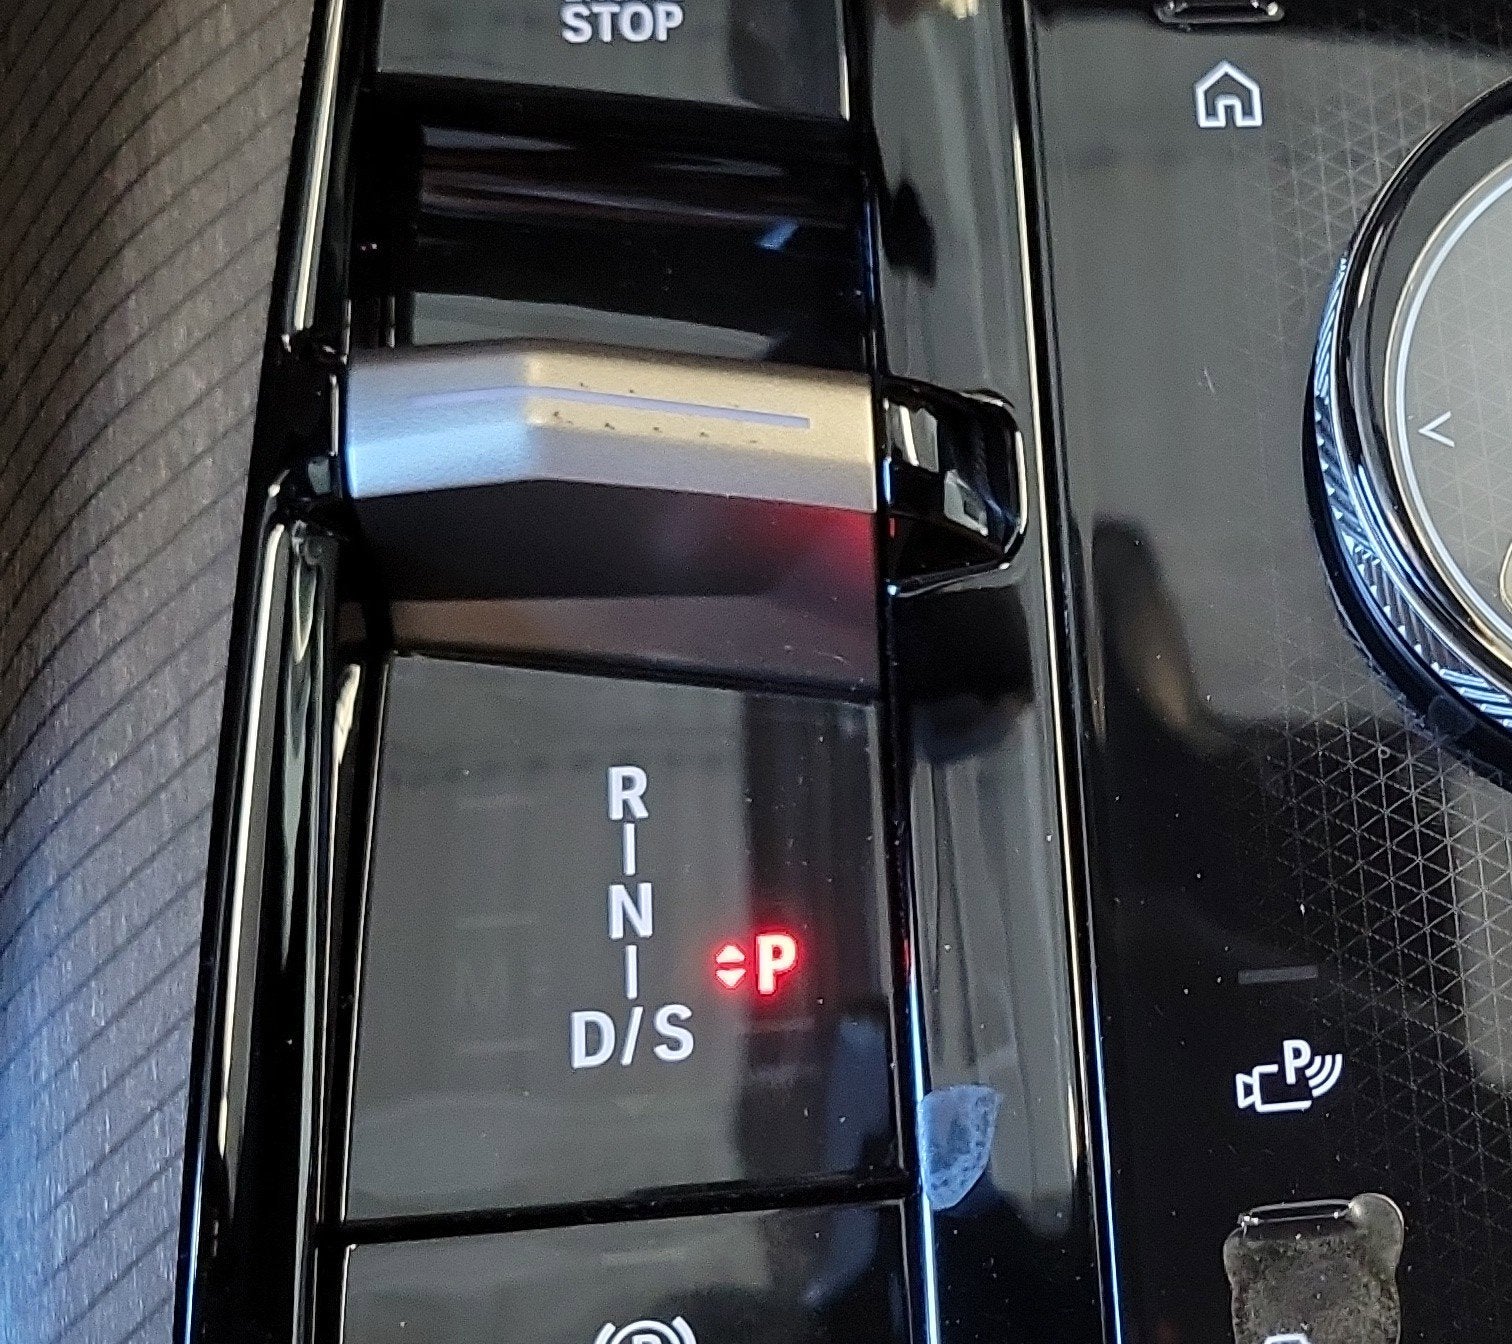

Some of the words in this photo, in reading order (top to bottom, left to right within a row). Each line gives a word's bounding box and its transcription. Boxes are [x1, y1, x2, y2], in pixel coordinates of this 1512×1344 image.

[560, 3, 683, 43] STOP
[607, 765, 649, 821] R
[607, 882, 653, 940] N
[755, 933, 797, 995] P
[570, 1004, 694, 1070] D/S
[1282, 1038, 1312, 1085] P
